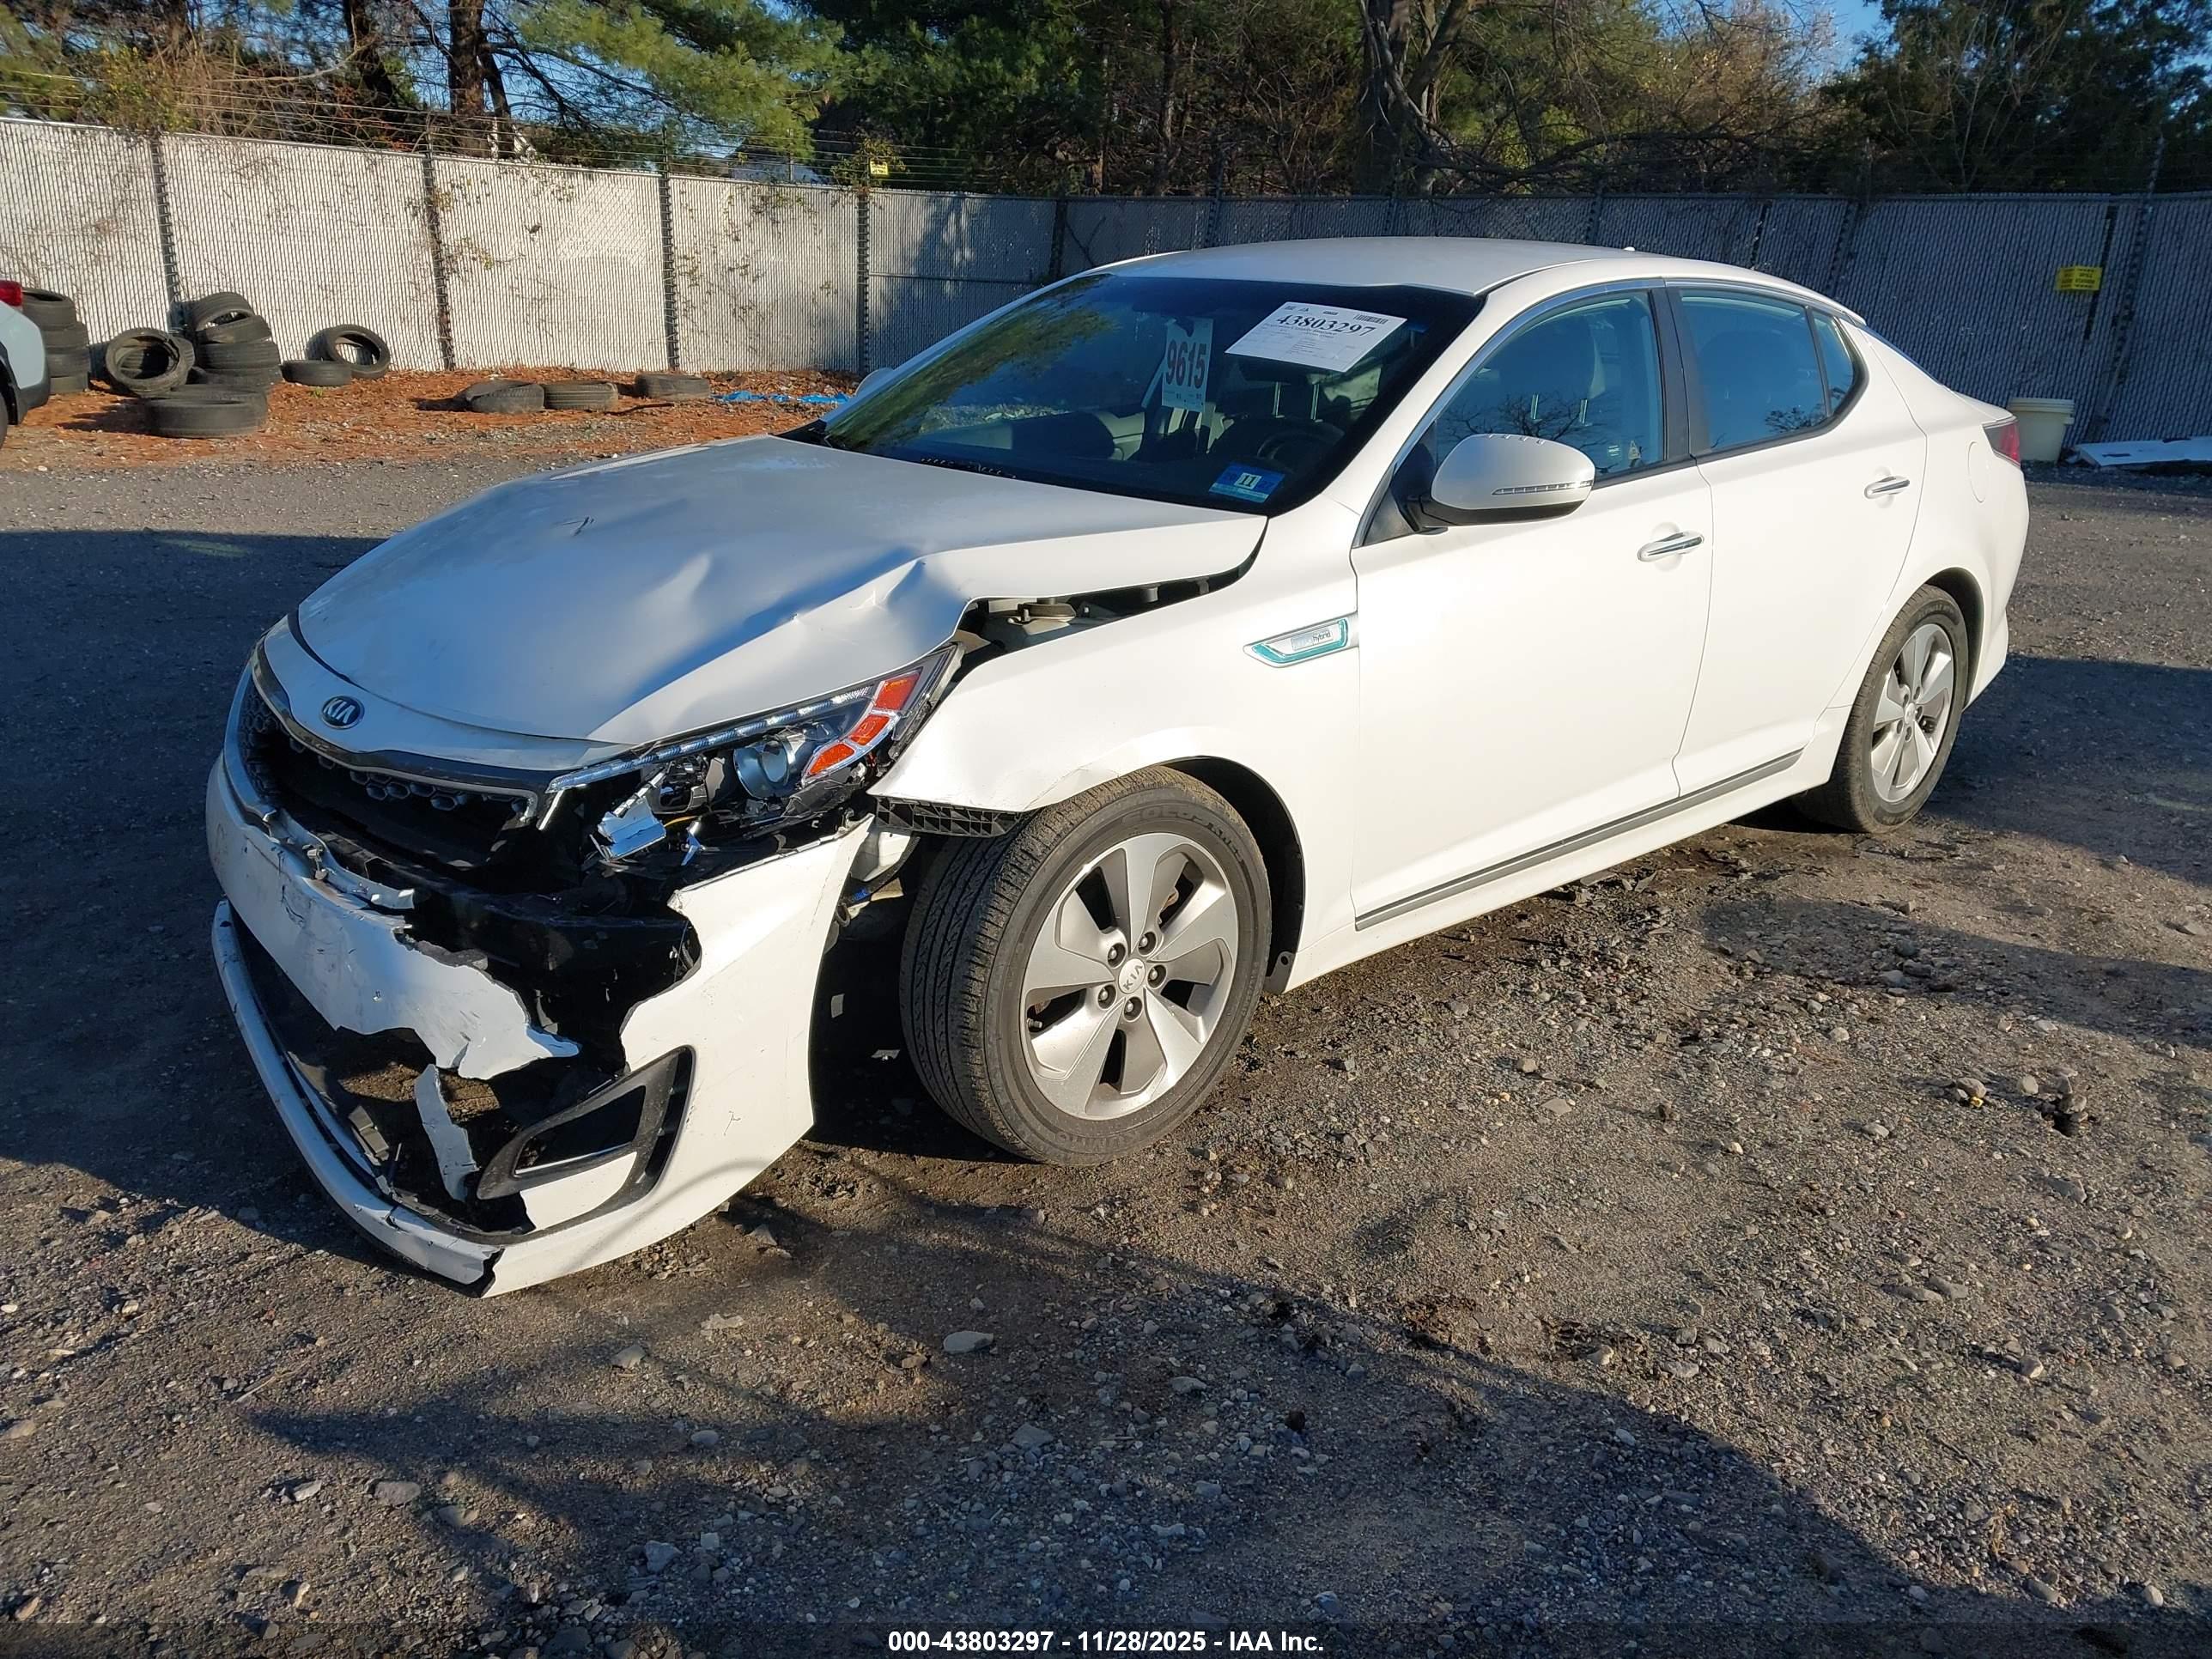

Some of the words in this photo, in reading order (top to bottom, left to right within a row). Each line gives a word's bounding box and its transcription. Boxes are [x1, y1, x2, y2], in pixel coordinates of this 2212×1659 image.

[1277, 314, 1376, 337] 43803297
[1165, 339, 1206, 388] 9615
[1239, 475, 1257, 487] 11
[323, 697, 356, 724] KIA
[1122, 964, 1143, 991] KIA
